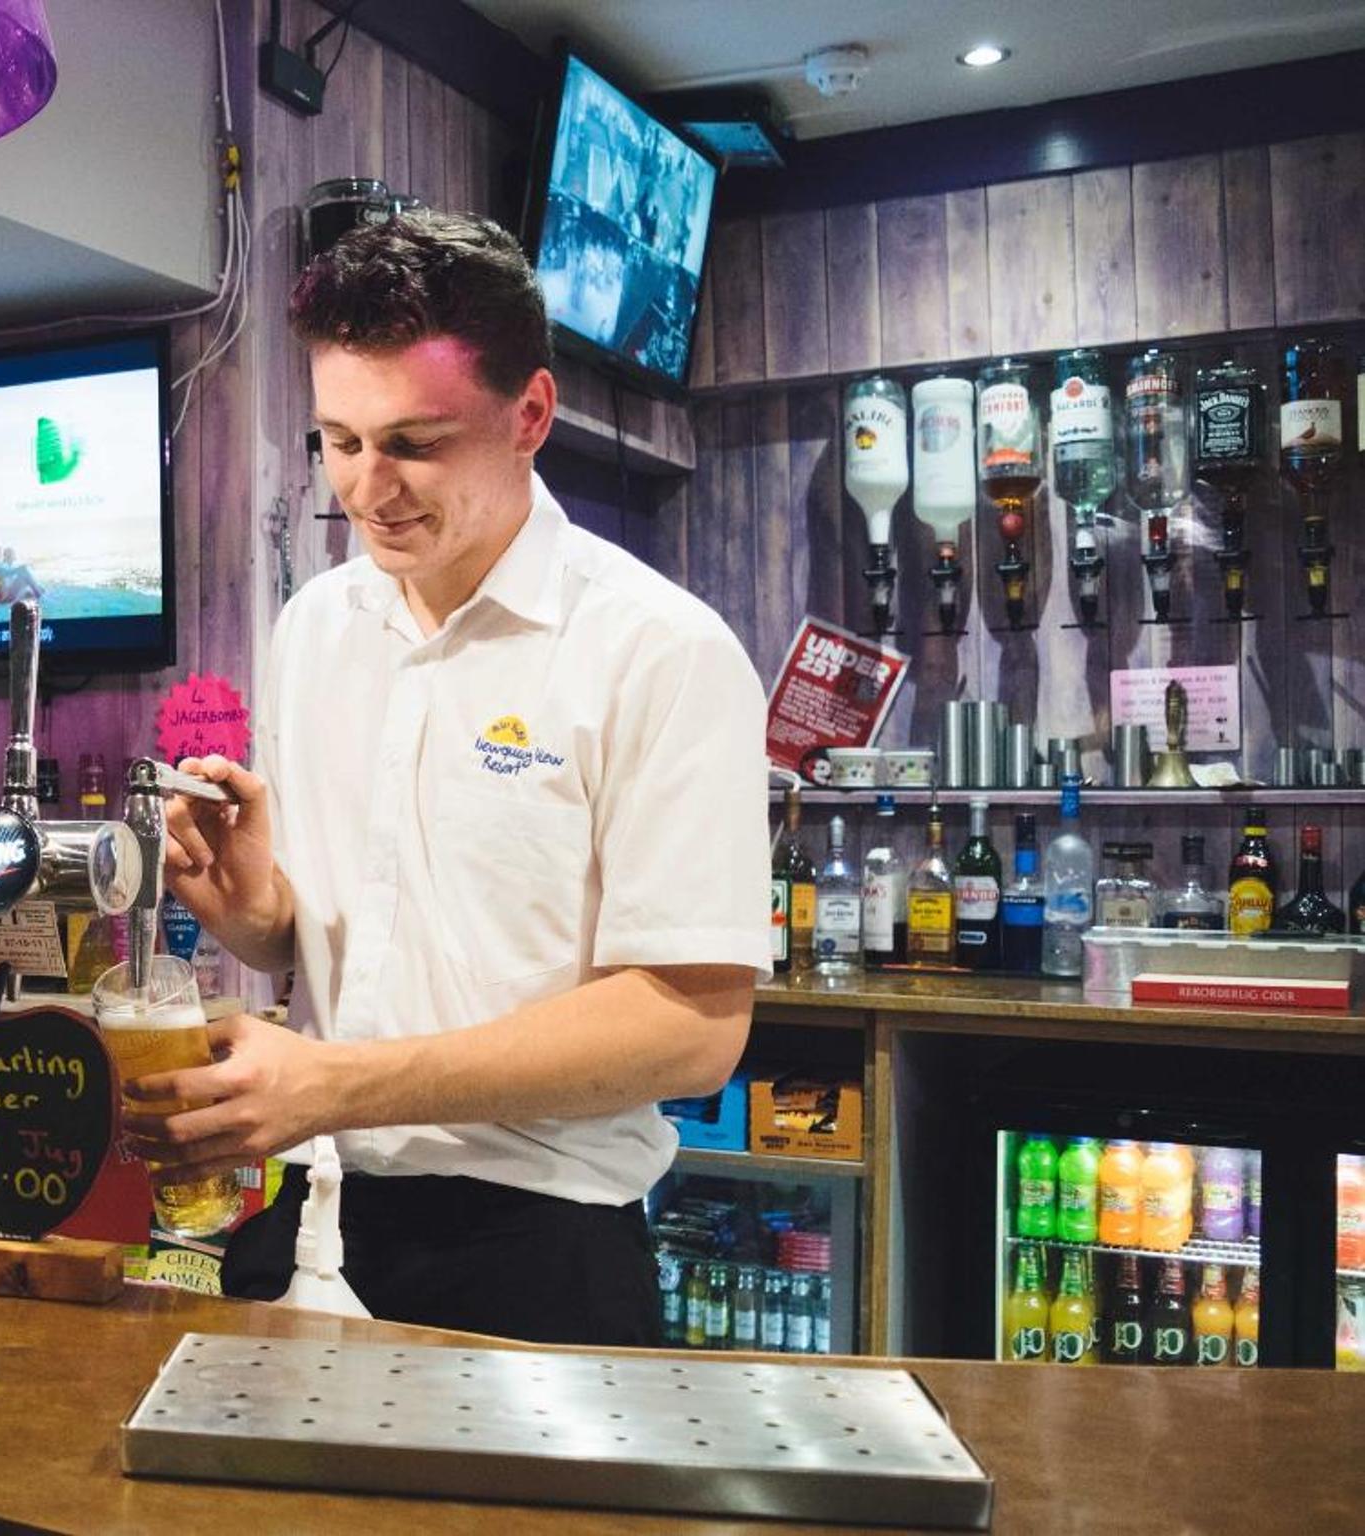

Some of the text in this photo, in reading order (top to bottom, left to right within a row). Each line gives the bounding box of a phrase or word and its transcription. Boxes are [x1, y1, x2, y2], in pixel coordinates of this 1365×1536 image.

[794, 650, 842, 682] 25?
[805, 632, 892, 684] UNDER
[1178, 986, 1296, 1002] REKORDERLIG CIDER
[17, 1129, 83, 1179] Jug
[166, 1252, 217, 1273] CHEES
